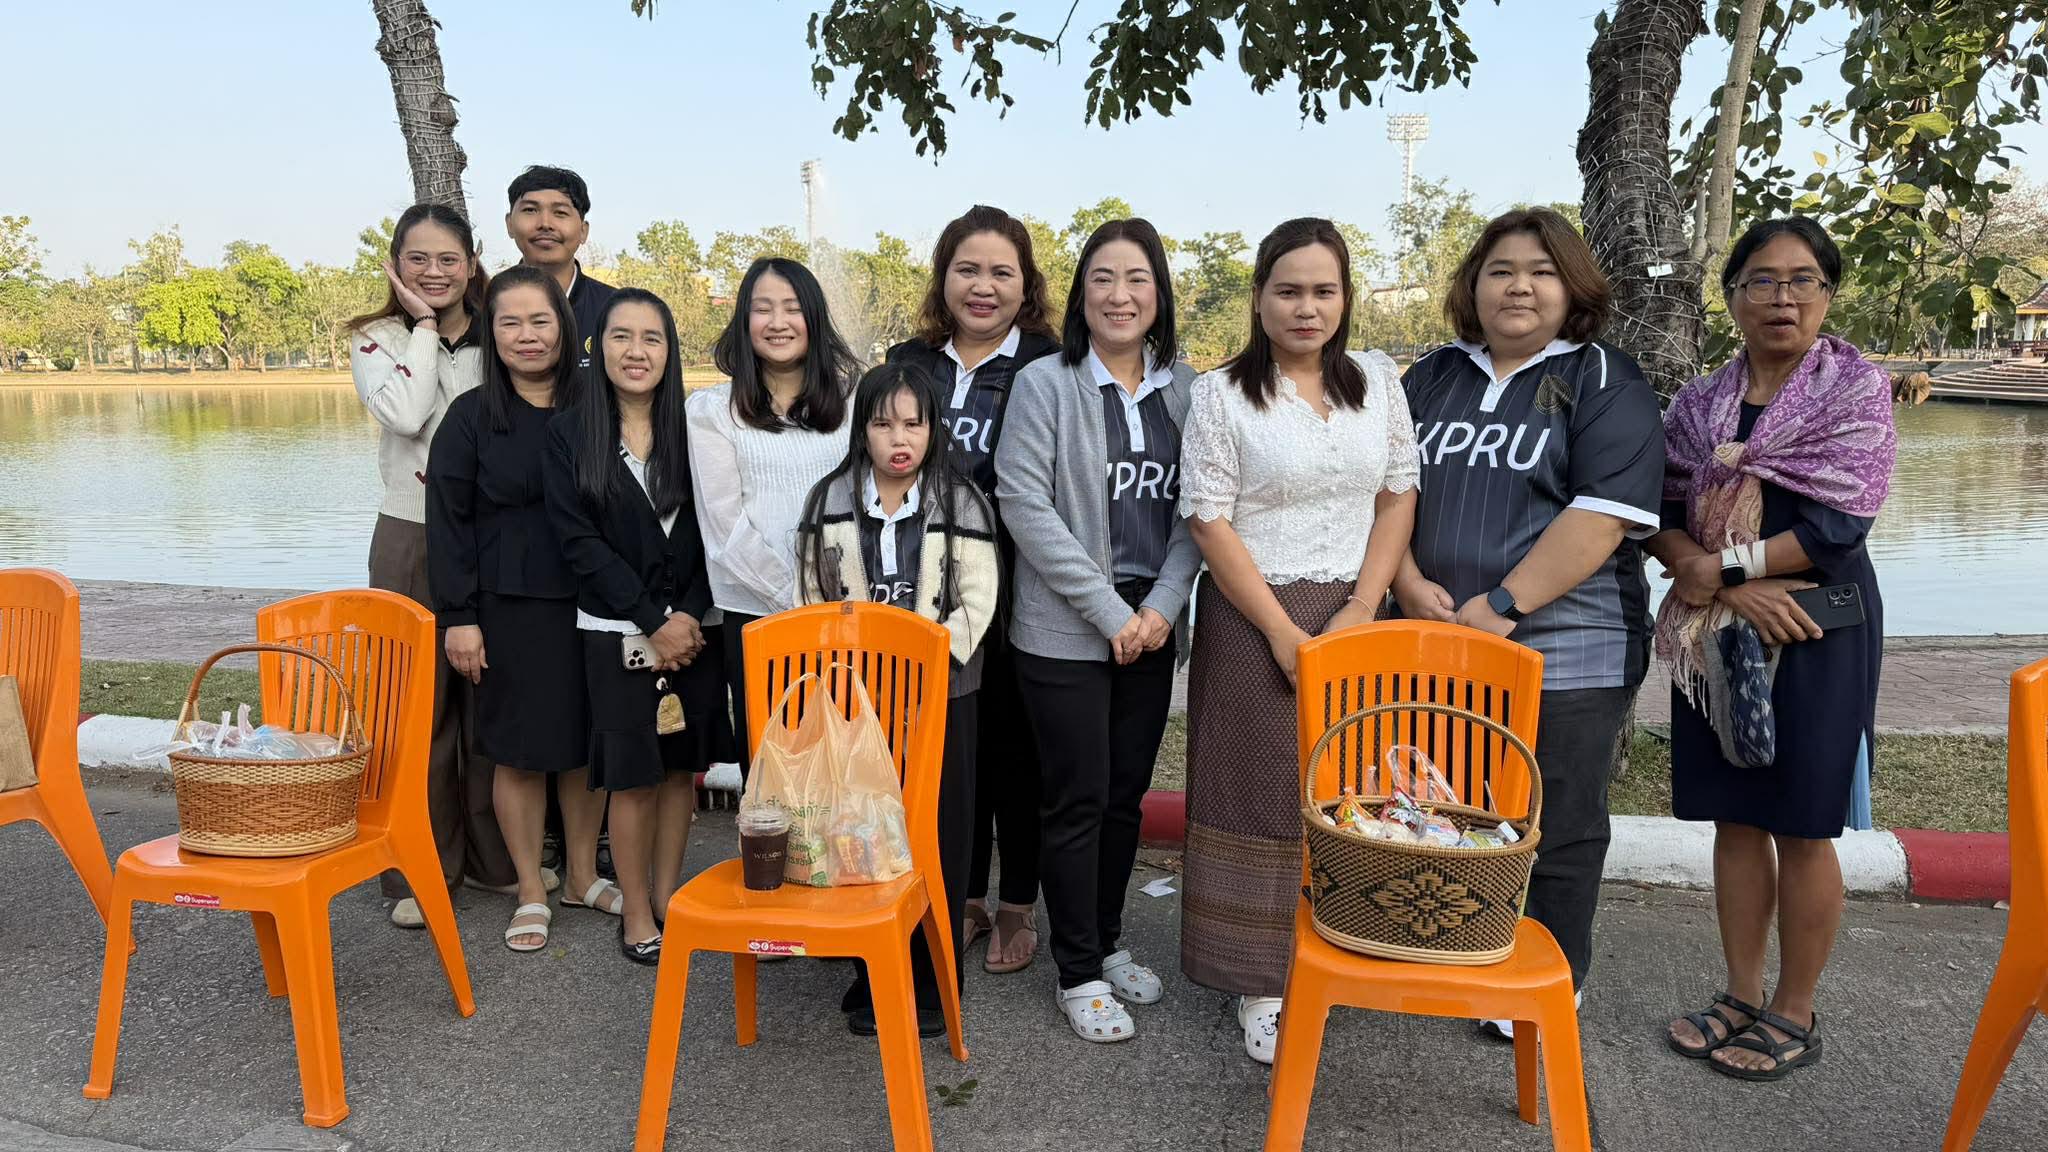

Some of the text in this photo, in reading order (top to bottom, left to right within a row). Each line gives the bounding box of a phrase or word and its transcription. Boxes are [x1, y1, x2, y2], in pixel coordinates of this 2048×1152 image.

[941, 416, 992, 453] RU
[1415, 421, 1551, 471] KPRU
[1107, 461, 1177, 500] PRU
